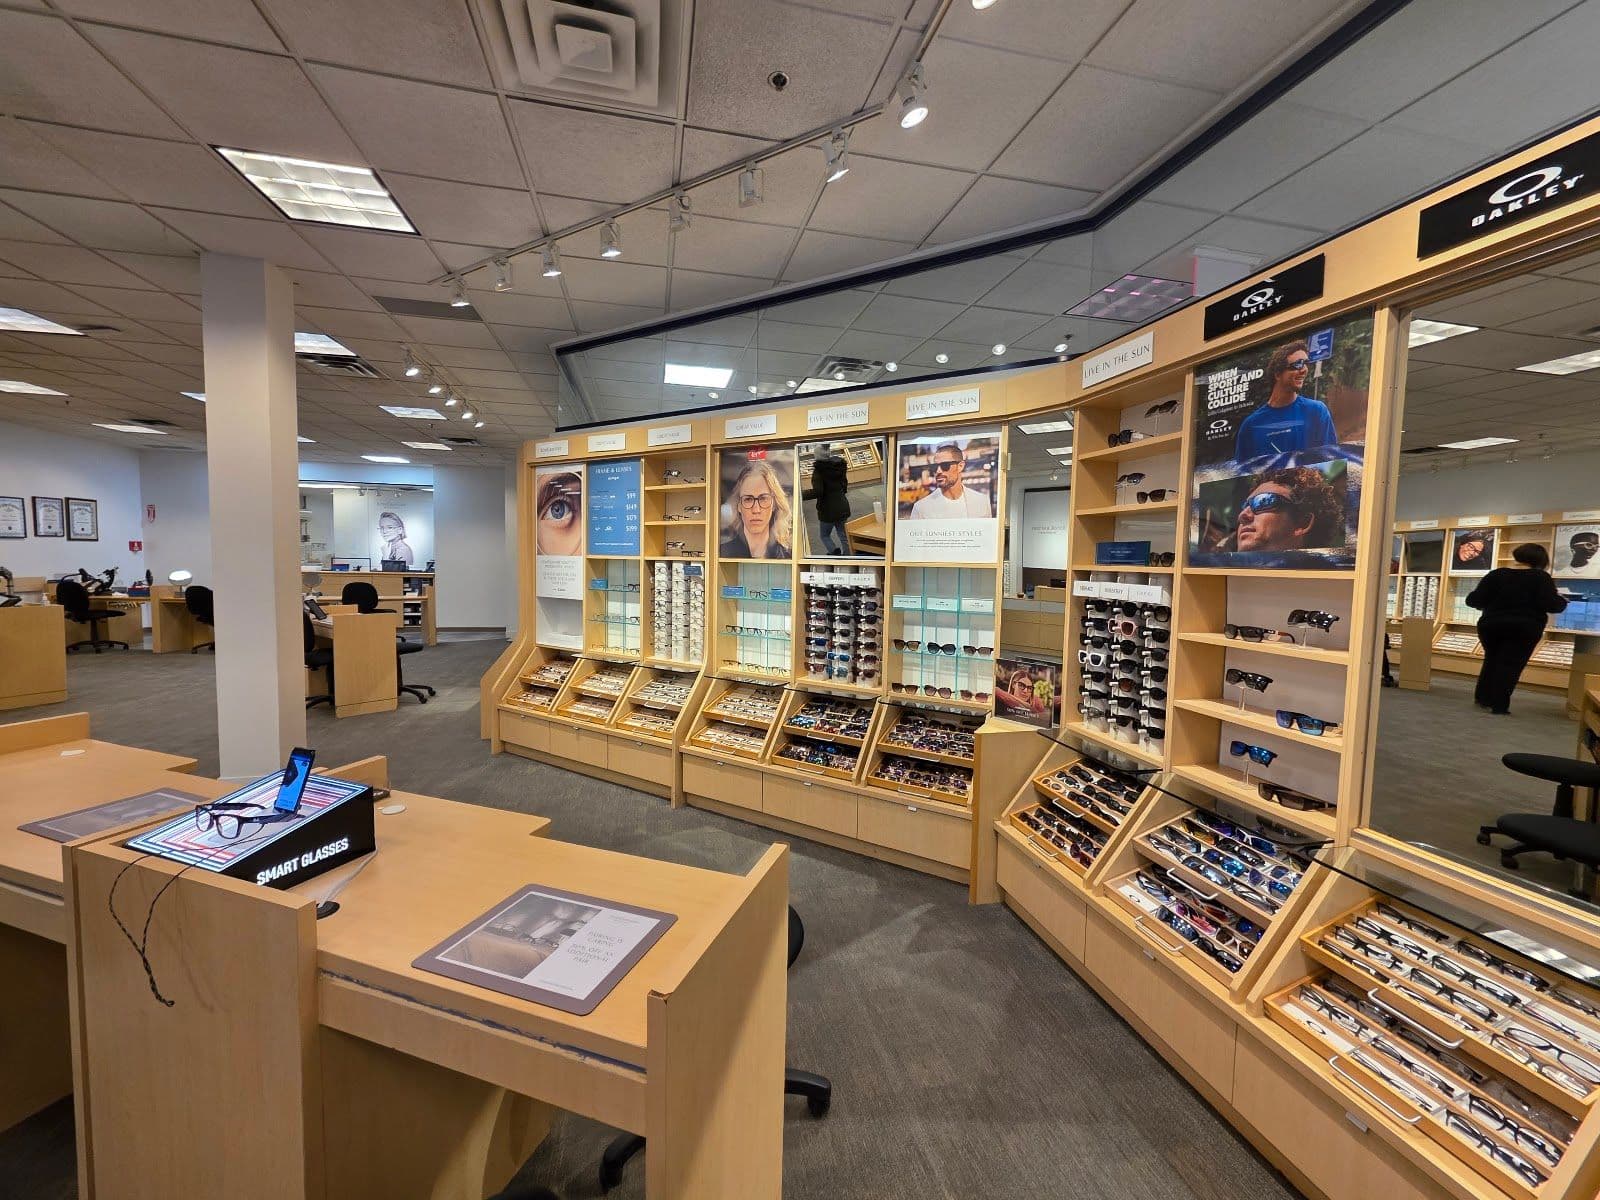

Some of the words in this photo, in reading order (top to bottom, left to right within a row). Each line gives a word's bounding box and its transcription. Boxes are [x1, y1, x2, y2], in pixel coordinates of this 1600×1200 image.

[1471, 174, 1580, 227] OAKLEY
[1233, 295, 1282, 321] OAKLEY
[1084, 365, 1100, 379] LIVE
[1102, 361, 1111, 371] IN
[1114, 352, 1129, 366] THE
[1131, 344, 1150, 359] SUN
[1208, 367, 1238, 384] WHEN
[1208, 375, 1241, 393] SPORT
[1240, 368, 1264, 383] AND
[1207, 382, 1249, 401] CULTURE
[1207, 392, 1246, 410] COLLIDE
[908, 403, 925, 412] LIVE
[928, 401, 937, 409] IN
[940, 399, 955, 408] THE
[959, 397, 977, 406] SUN
[809, 415, 825, 424] LIVE
[836, 412, 849, 421] THE
[851, 409, 867, 418] SUN
[256, 857, 299, 886] SMART
[301, 837, 349, 868] GLASSES
